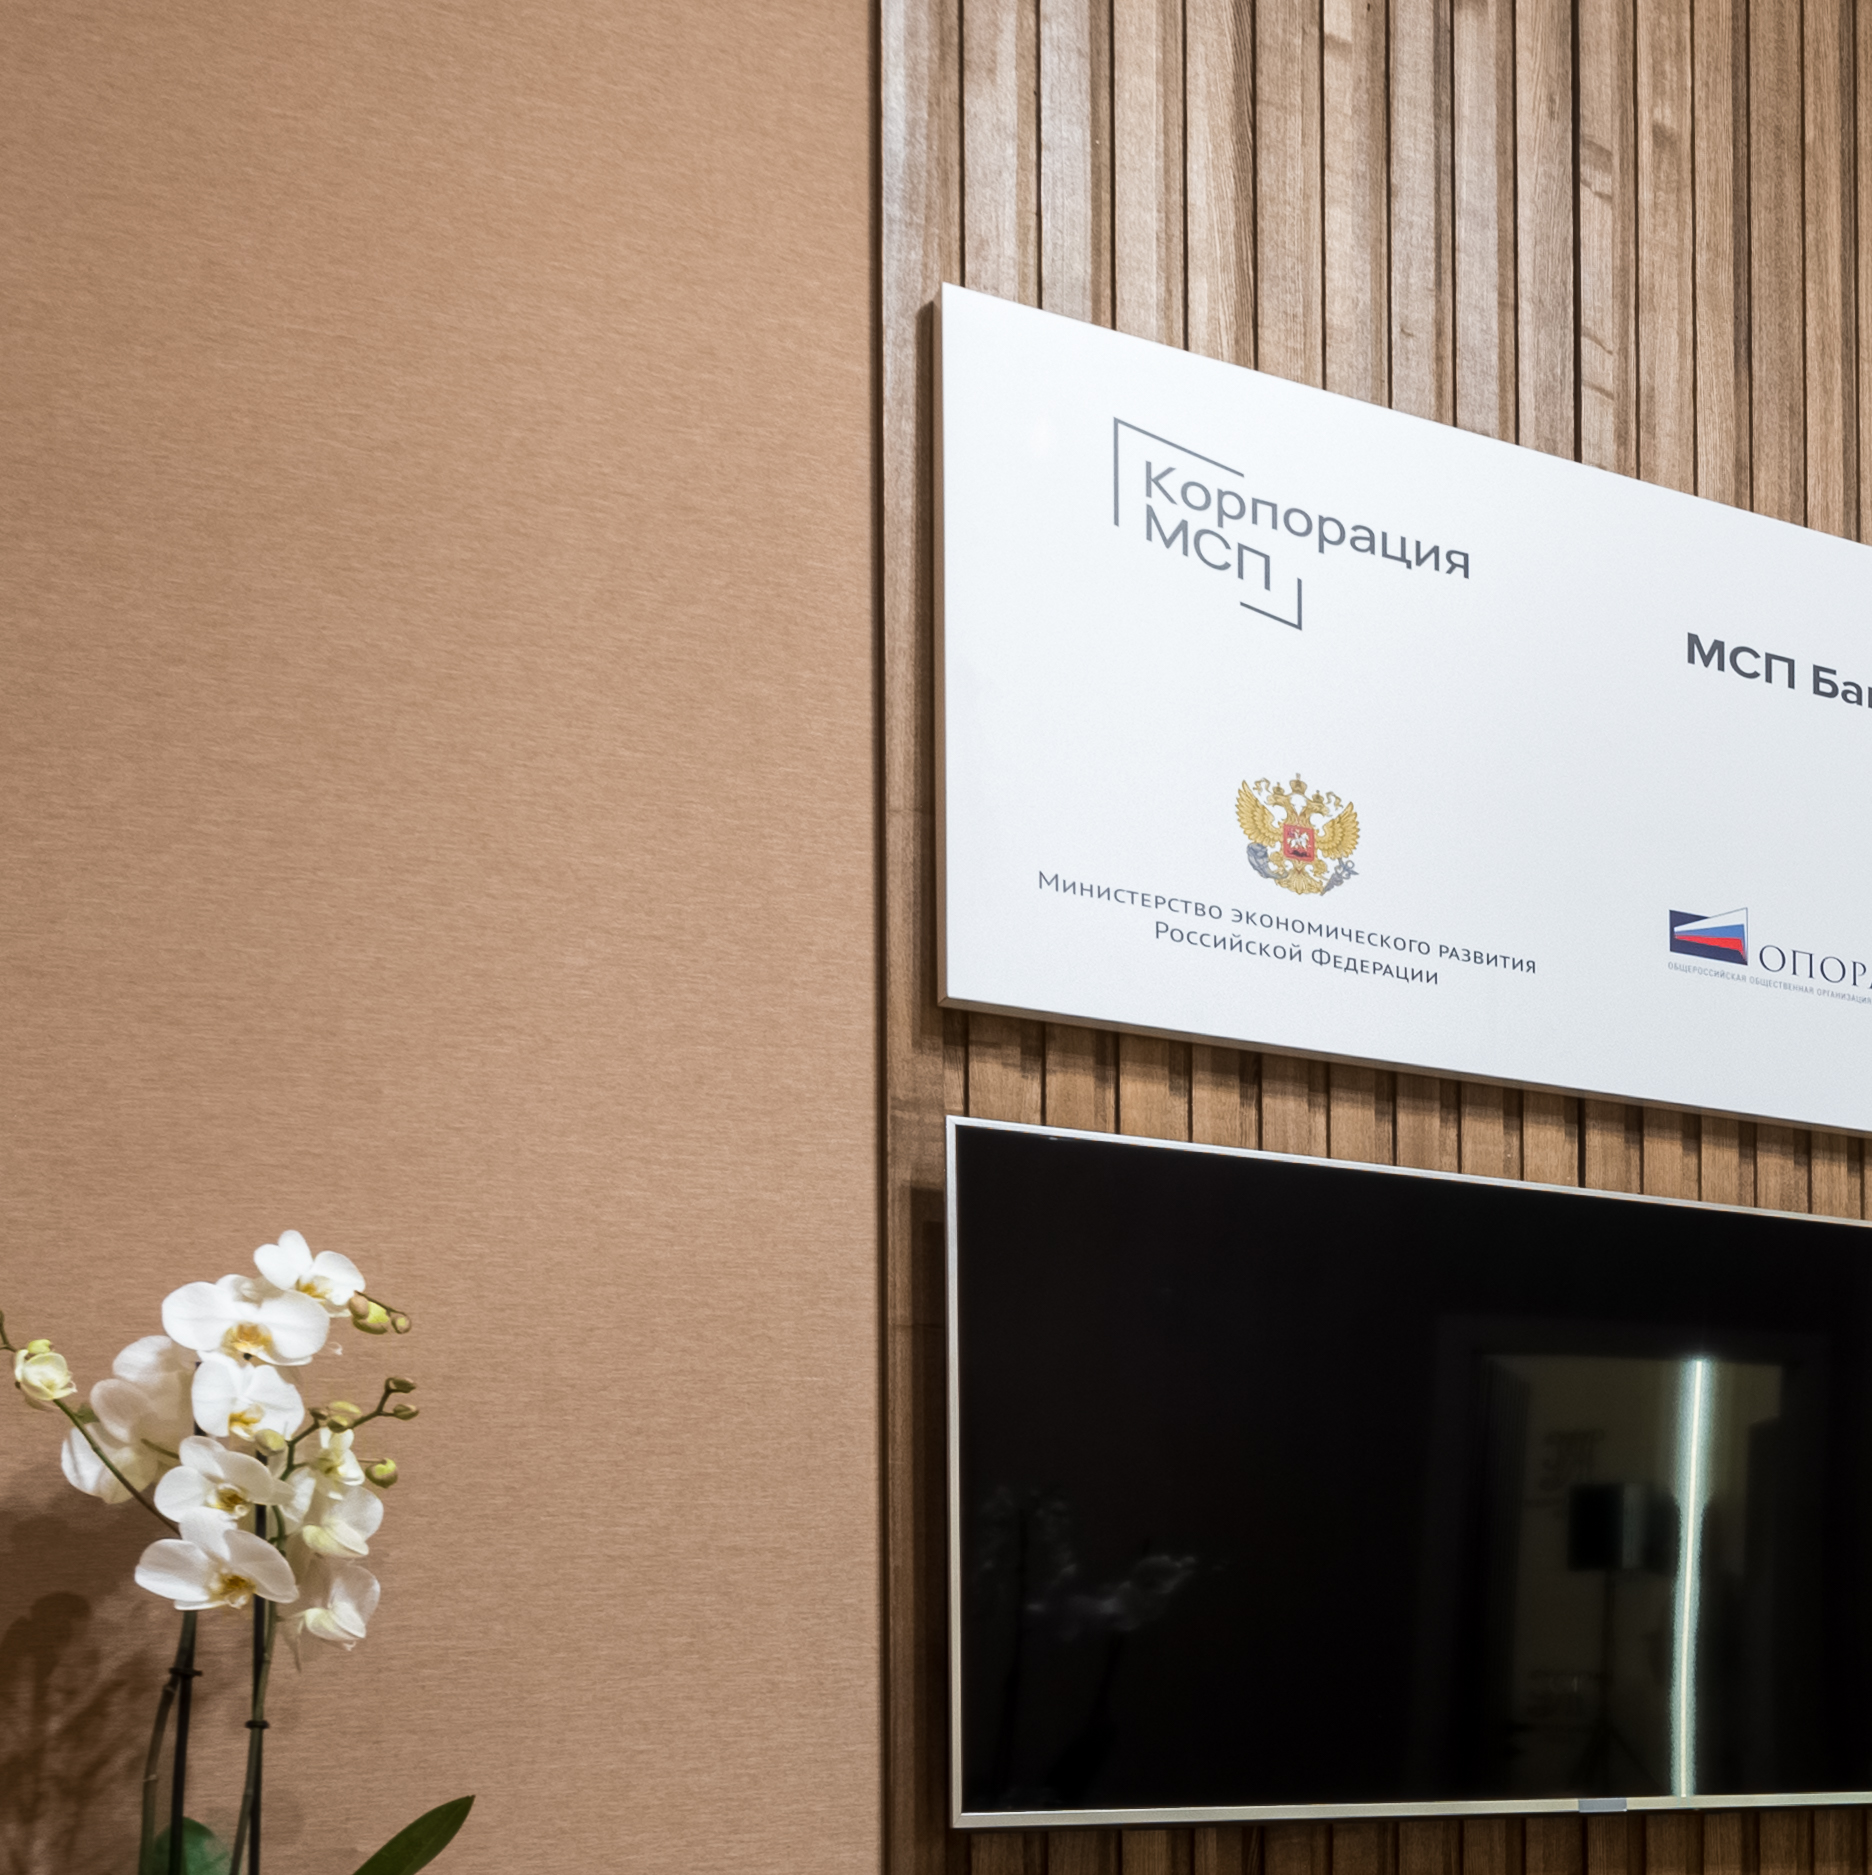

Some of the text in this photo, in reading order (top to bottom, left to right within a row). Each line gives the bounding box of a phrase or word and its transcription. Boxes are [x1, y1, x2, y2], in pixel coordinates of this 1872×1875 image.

[1145, 460, 1470, 579] Корпорация
[1145, 503, 1271, 592] МСП
[1687, 632, 1796, 690] МСП
[1667, 961, 1747, 983] ОБЩЕРОССИЙСКАЯ
[1749, 976, 1814, 995] ОБЩЕСТВЕННАЯ
[1816, 988, 1872, 1005] ОРГАНИЗАЦИЯ
